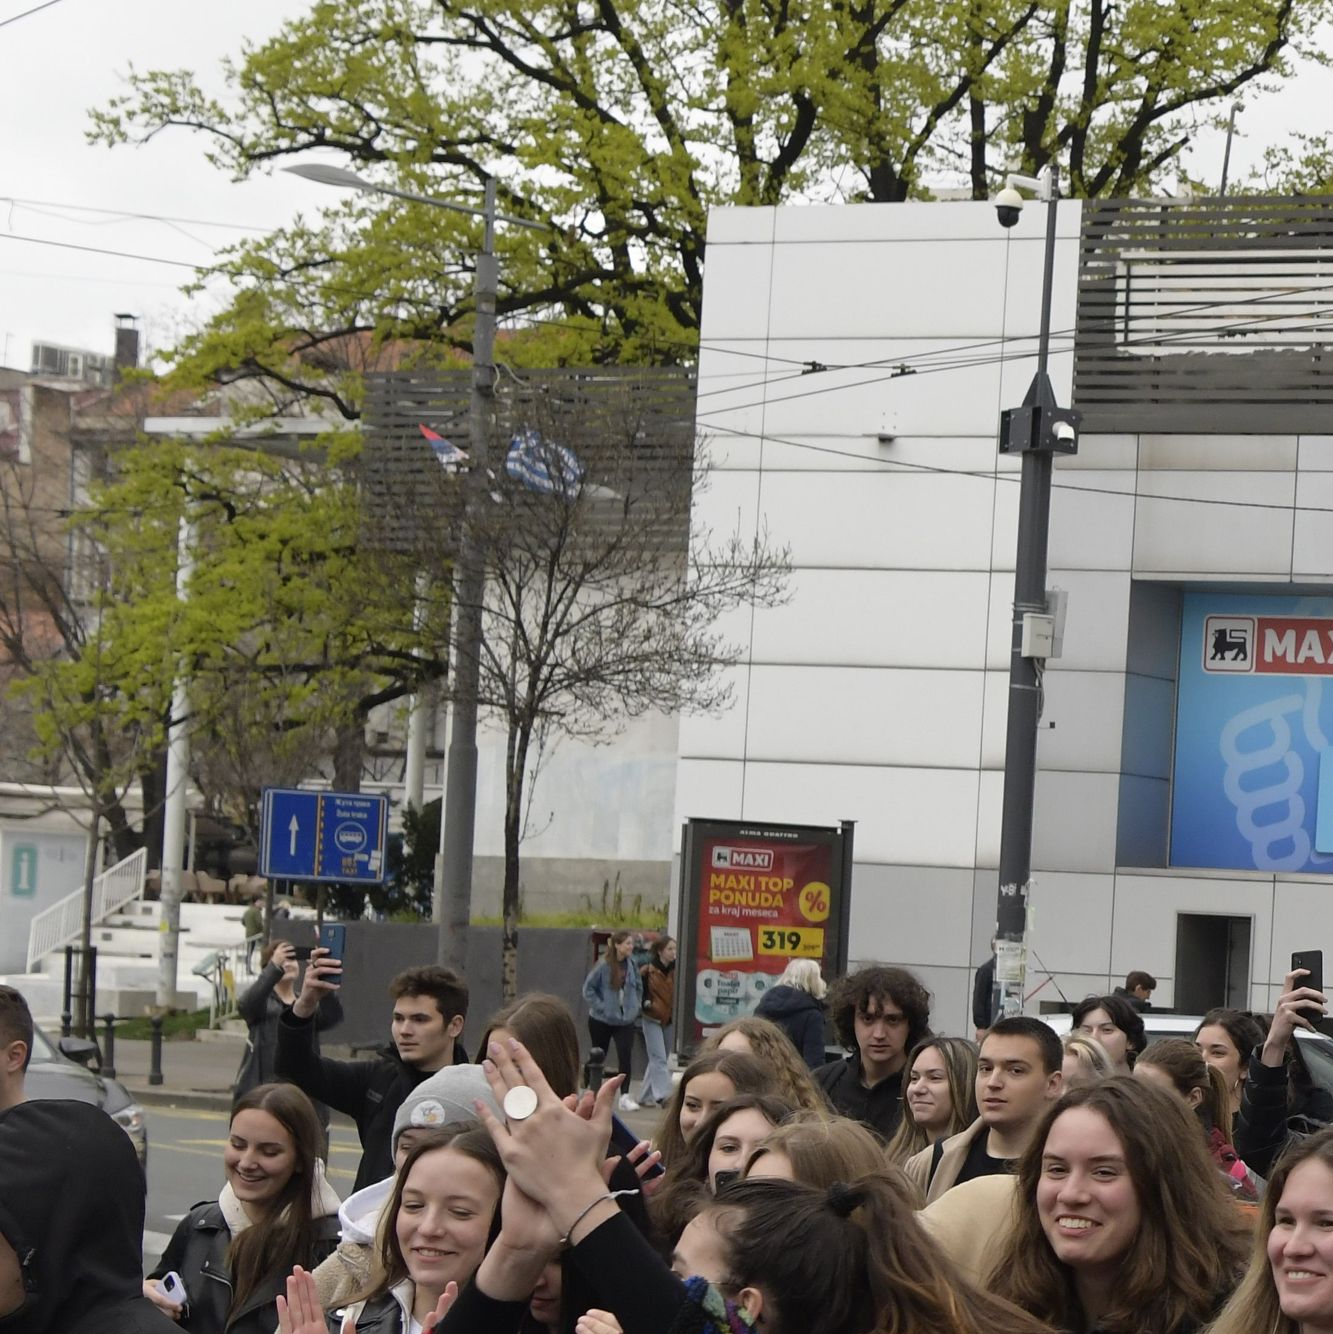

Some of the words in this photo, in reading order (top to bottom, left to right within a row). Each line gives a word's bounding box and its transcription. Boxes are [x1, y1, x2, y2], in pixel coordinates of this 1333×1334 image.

[732, 852, 768, 867] MAXI
[710, 873, 755, 890] MAXI
[758, 876, 794, 892] TOP
[709, 890, 783, 908] PONUDA
[709, 906, 719, 914] za
[722, 905, 740, 918] kraj
[742, 909, 778, 918] meseca
[762, 930, 801, 950] 319
